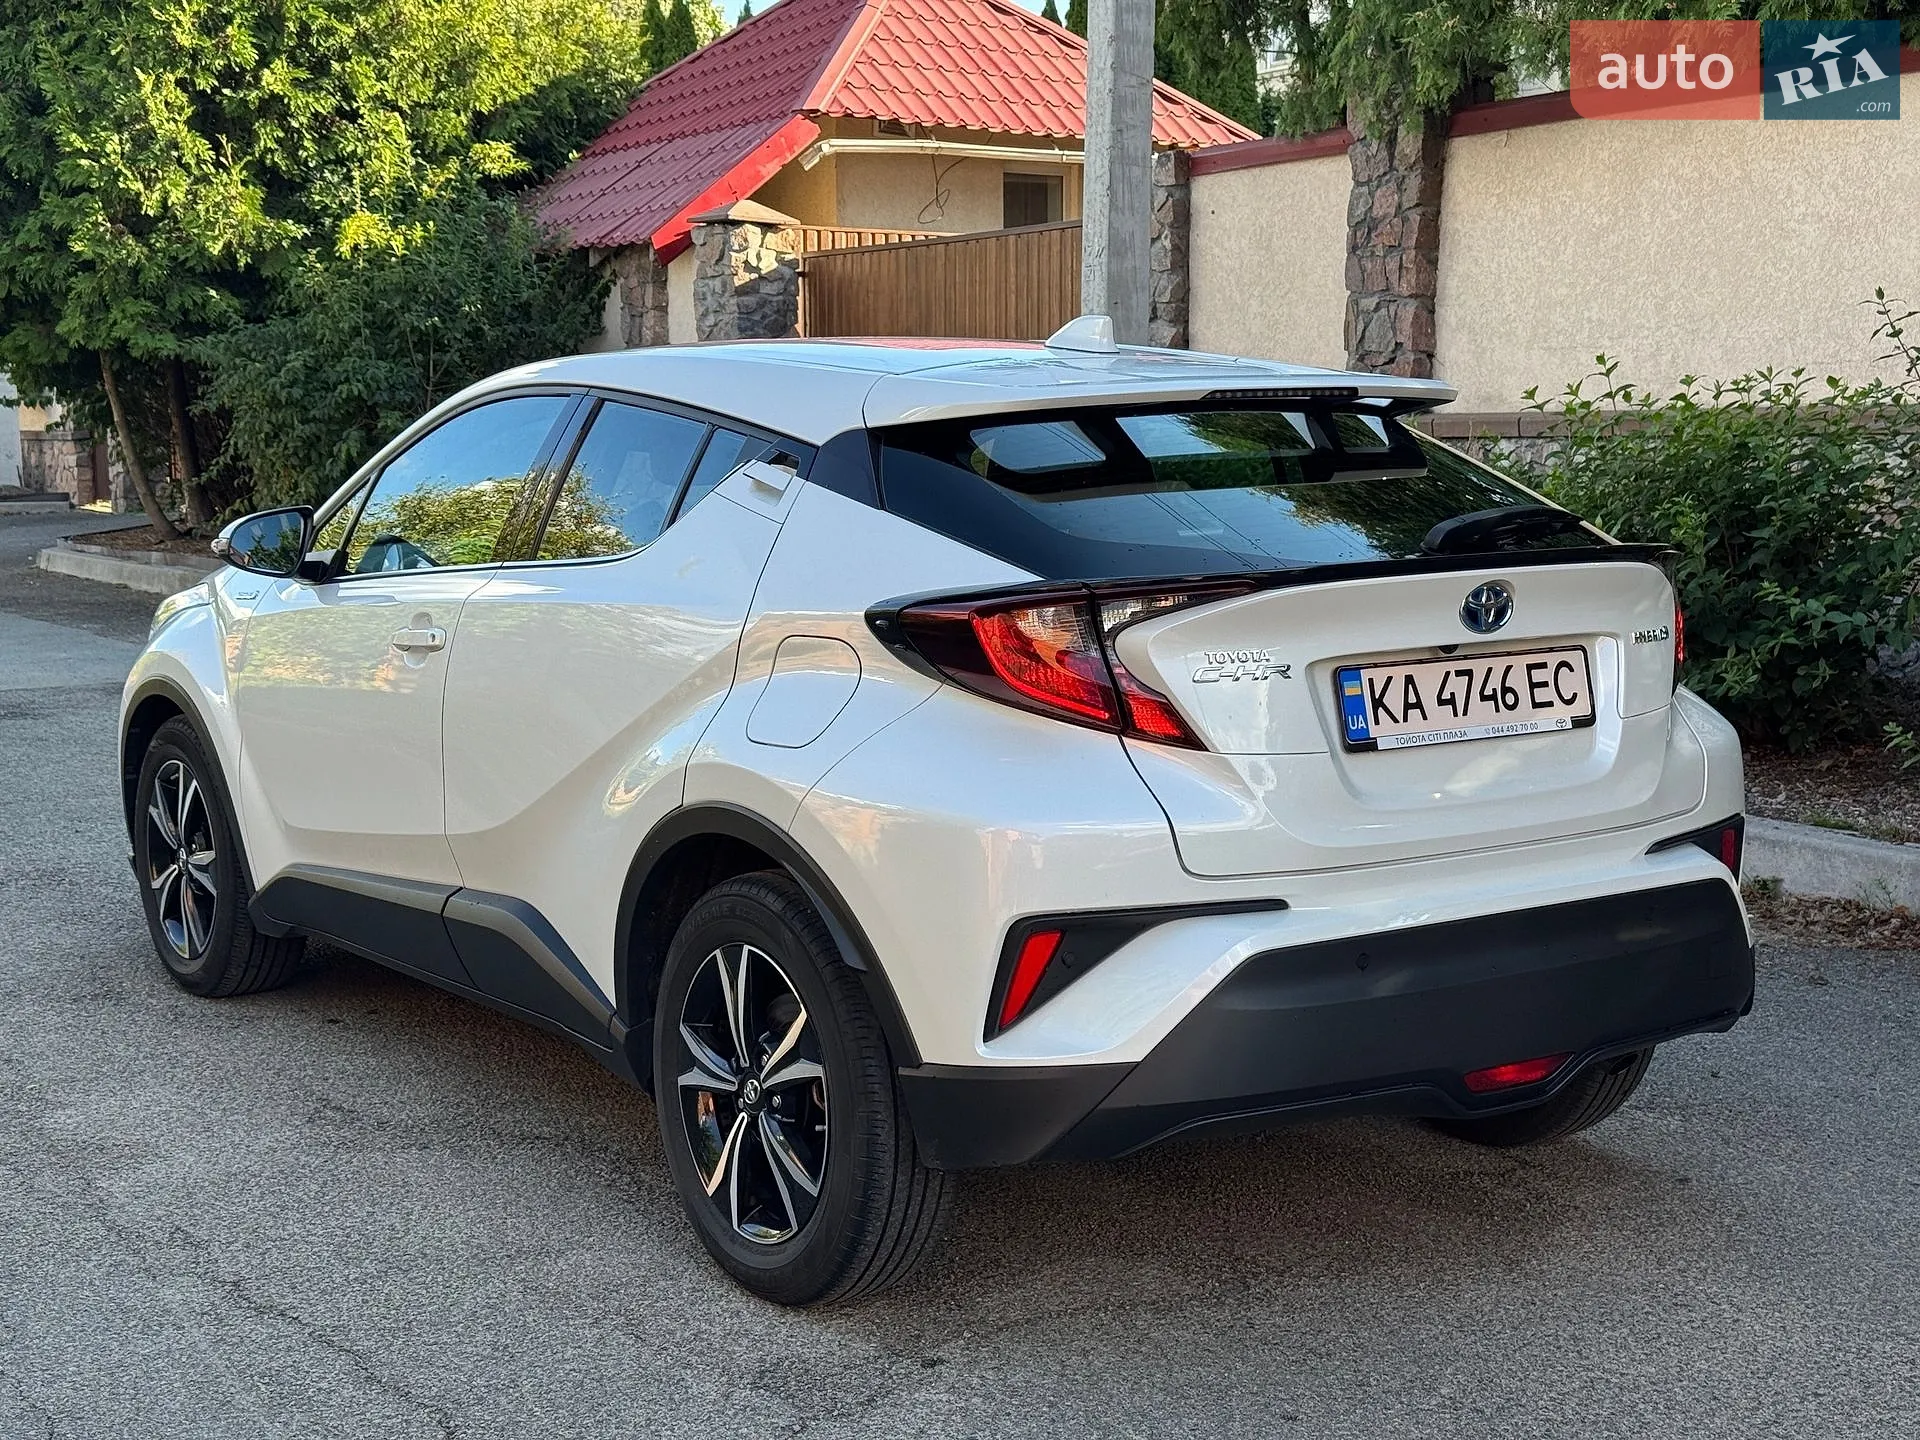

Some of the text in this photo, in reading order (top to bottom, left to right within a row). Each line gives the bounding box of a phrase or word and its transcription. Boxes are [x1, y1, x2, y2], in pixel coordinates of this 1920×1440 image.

[1204, 649, 1271, 665] TOYOTA
[1192, 663, 1292, 683] C-HR
[1368, 660, 1578, 726] KA 4746 EC
[1348, 717, 1367, 731] UA
[1491, 725, 1504, 735] 044
